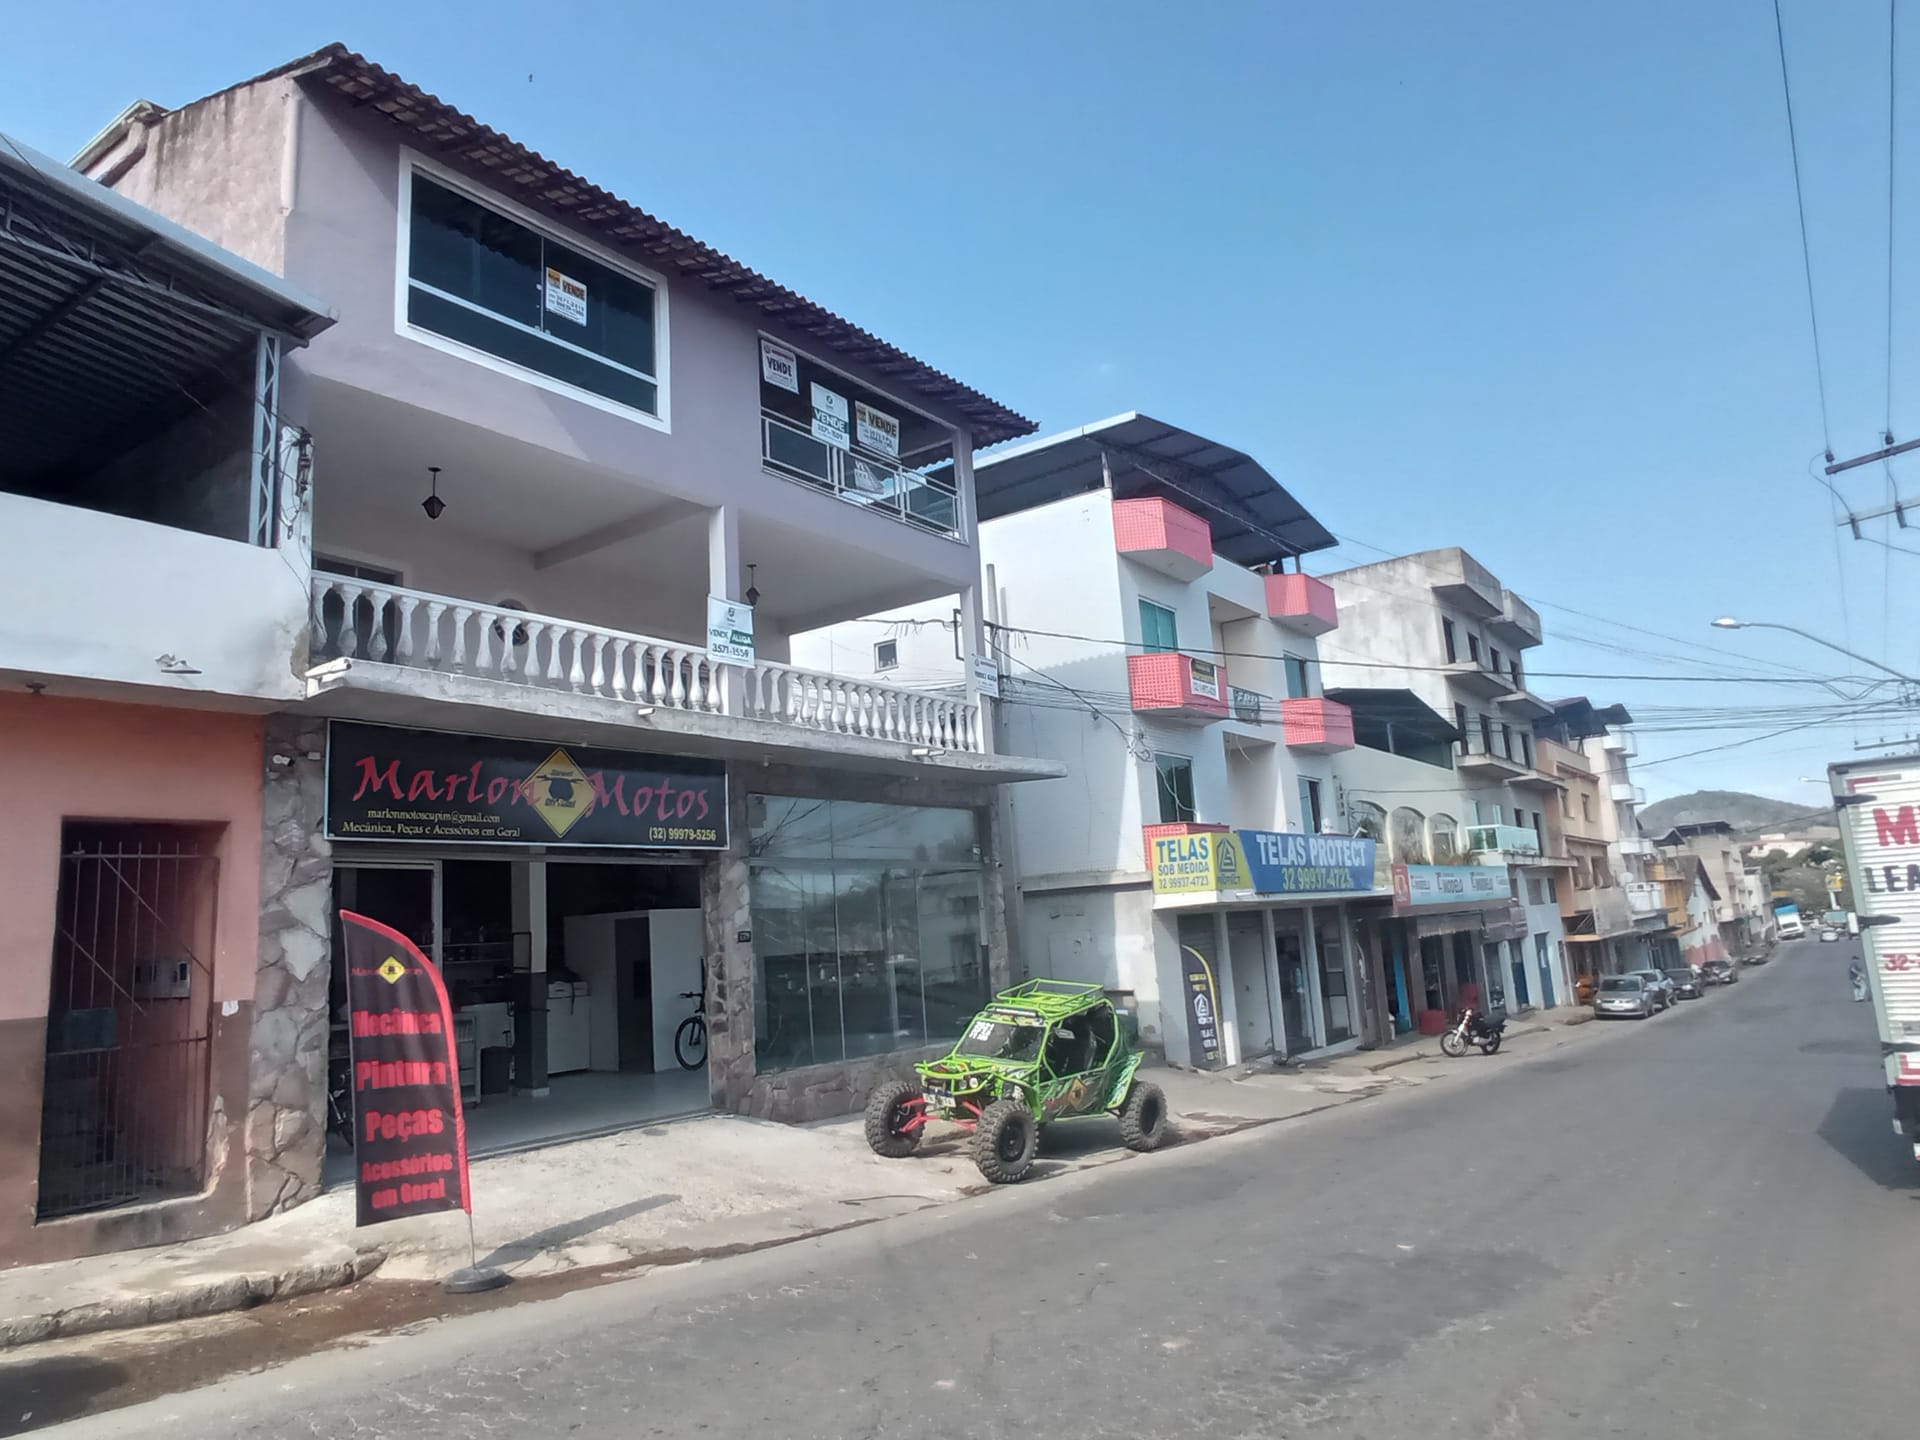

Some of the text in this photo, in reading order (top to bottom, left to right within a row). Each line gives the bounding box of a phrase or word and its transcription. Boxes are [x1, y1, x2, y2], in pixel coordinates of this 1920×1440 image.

[766, 355, 792, 377] VENDE
[814, 408, 845, 432] VENDE
[868, 412, 897, 437] VENDE
[352, 756, 709, 822] Marlon Motos
[398, 823, 423, 836] Peças
[481, 828, 495, 836] em
[497, 827, 520, 837] Geral
[649, 827, 666, 841] (32)
[1872, 805, 1920, 847] M
[1156, 837, 1209, 863] TELAS
[1256, 834, 1366, 867] TELAS PROTECT
[1158, 862, 1210, 876] SOB MEDIDA
[1281, 867, 1296, 890] 32
[1159, 878, 1167, 889] 32
[357, 1060, 447, 1090] Pintura
[366, 1109, 443, 1142] Peças
[371, 1178, 445, 1208] em Geral
